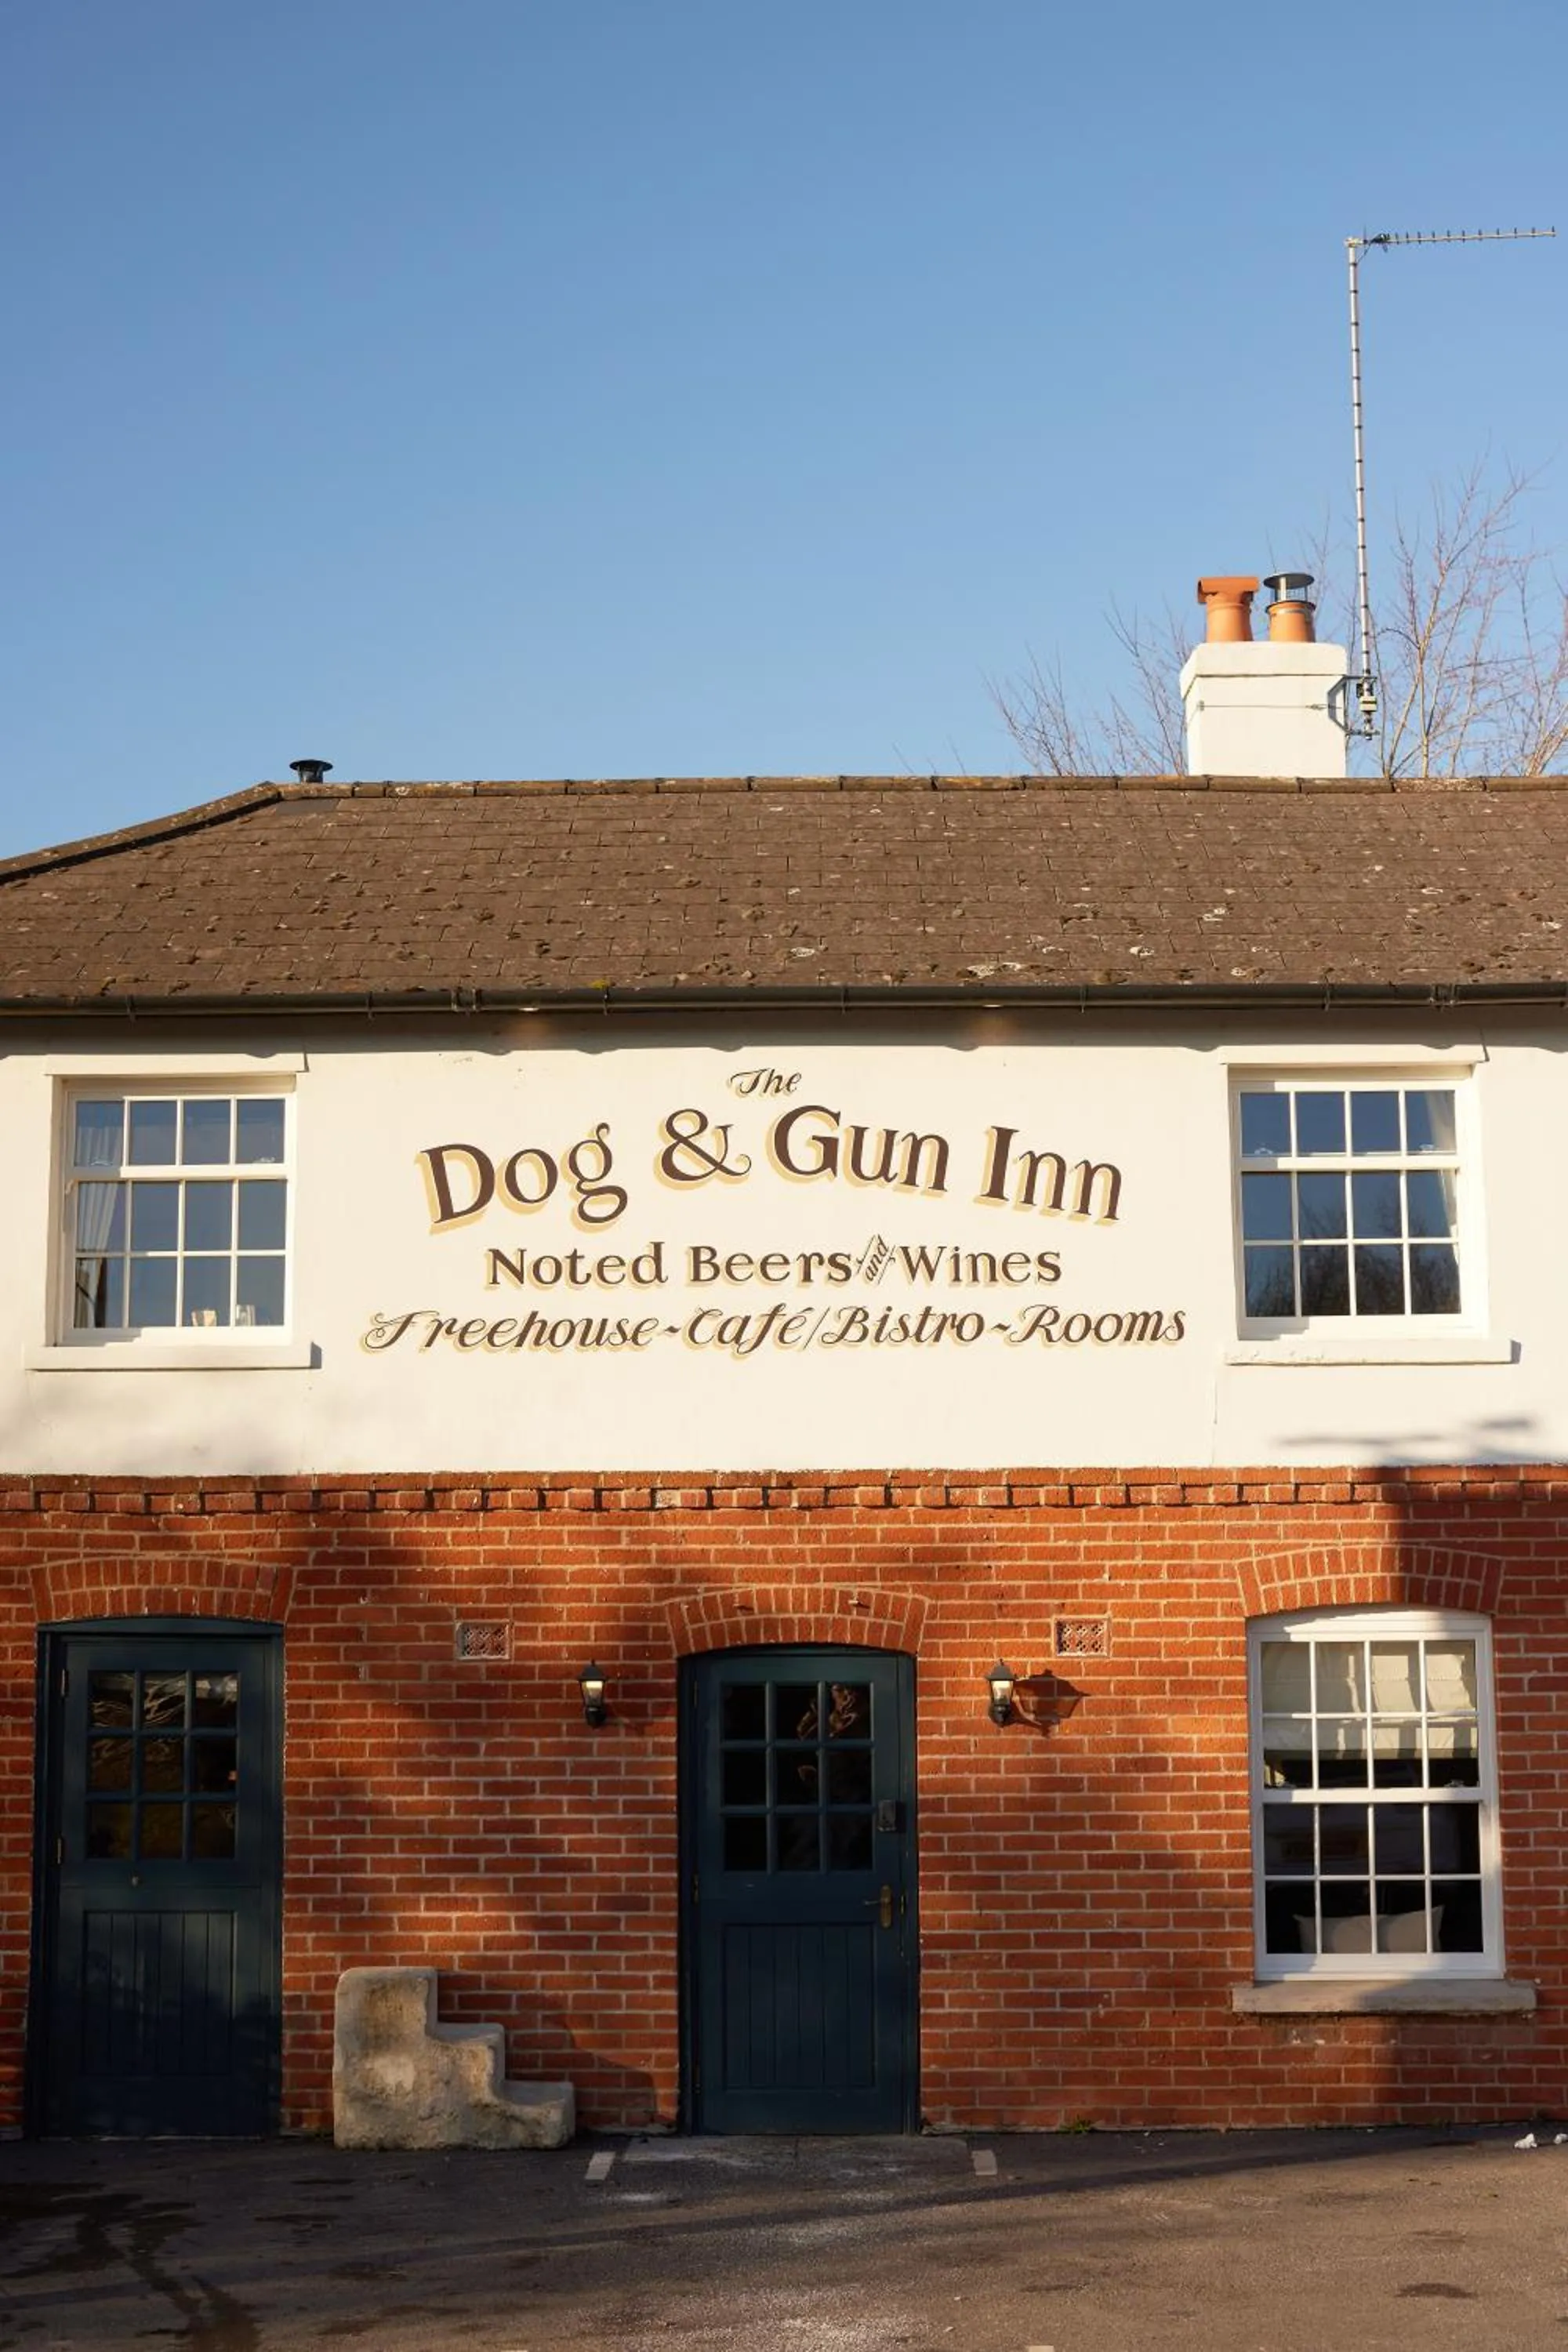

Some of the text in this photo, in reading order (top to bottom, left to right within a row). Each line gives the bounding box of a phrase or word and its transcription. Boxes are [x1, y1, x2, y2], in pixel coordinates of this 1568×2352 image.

[729, 1068, 801, 1095] The
[419, 1104, 1122, 1226] Dog & Gun Inn
[488, 1234, 1062, 1286] Noted Beers and Wines
